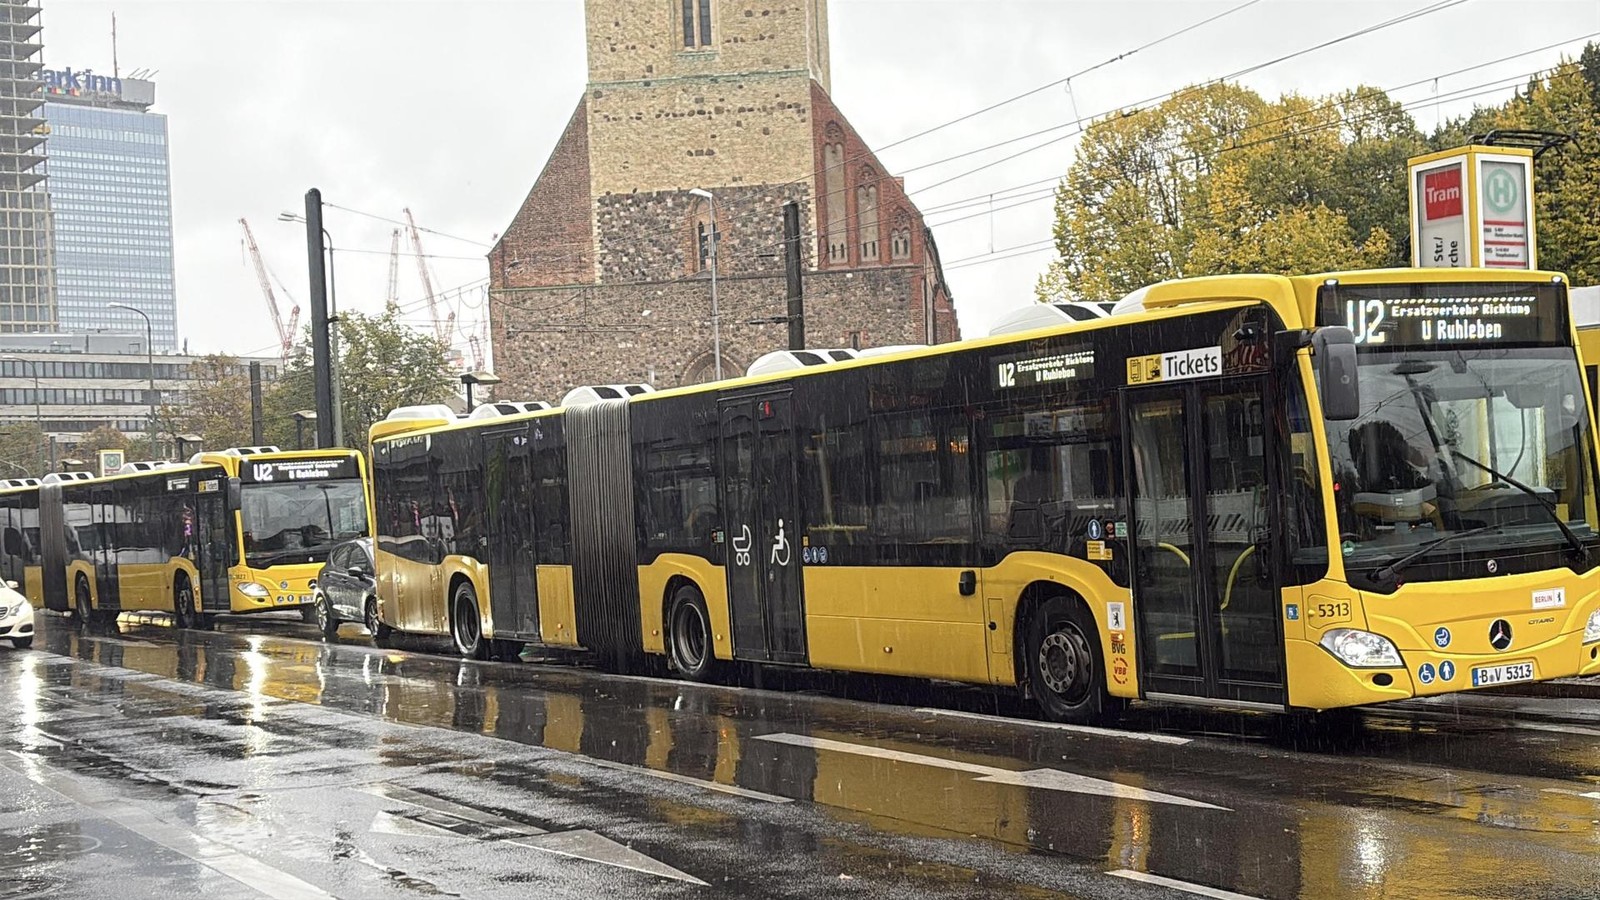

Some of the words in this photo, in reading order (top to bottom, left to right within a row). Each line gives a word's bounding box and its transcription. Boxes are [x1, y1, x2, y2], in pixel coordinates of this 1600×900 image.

[85, 69, 122, 92] inn
[1426, 185, 1460, 204] Tram
[1392, 304, 1479, 317] Ersatzverkehr
[1482, 303, 1530, 315] Richtung
[1347, 299, 1385, 344] U2
[1422, 319, 1432, 340] U
[1437, 319, 1502, 340] Ruhleben
[1017, 359, 1064, 372] Ersatzverkehr
[1065, 355, 1094, 366] Richtung
[1165, 353, 1218, 377] Tickets
[999, 362, 1015, 387] U2
[1036, 370, 1041, 382] U
[1043, 367, 1076, 381] Ruhleben
[253, 463, 273, 481] U2
[1535, 595, 1552, 603] BERLIN
[1318, 602, 1349, 618] 5313
[1111, 642, 1126, 655] BVG
[1114, 666, 1127, 676] VBB
[1481, 669, 1488, 683] B
[1494, 667, 1502, 681] V
[1506, 664, 1532, 680] 5313
